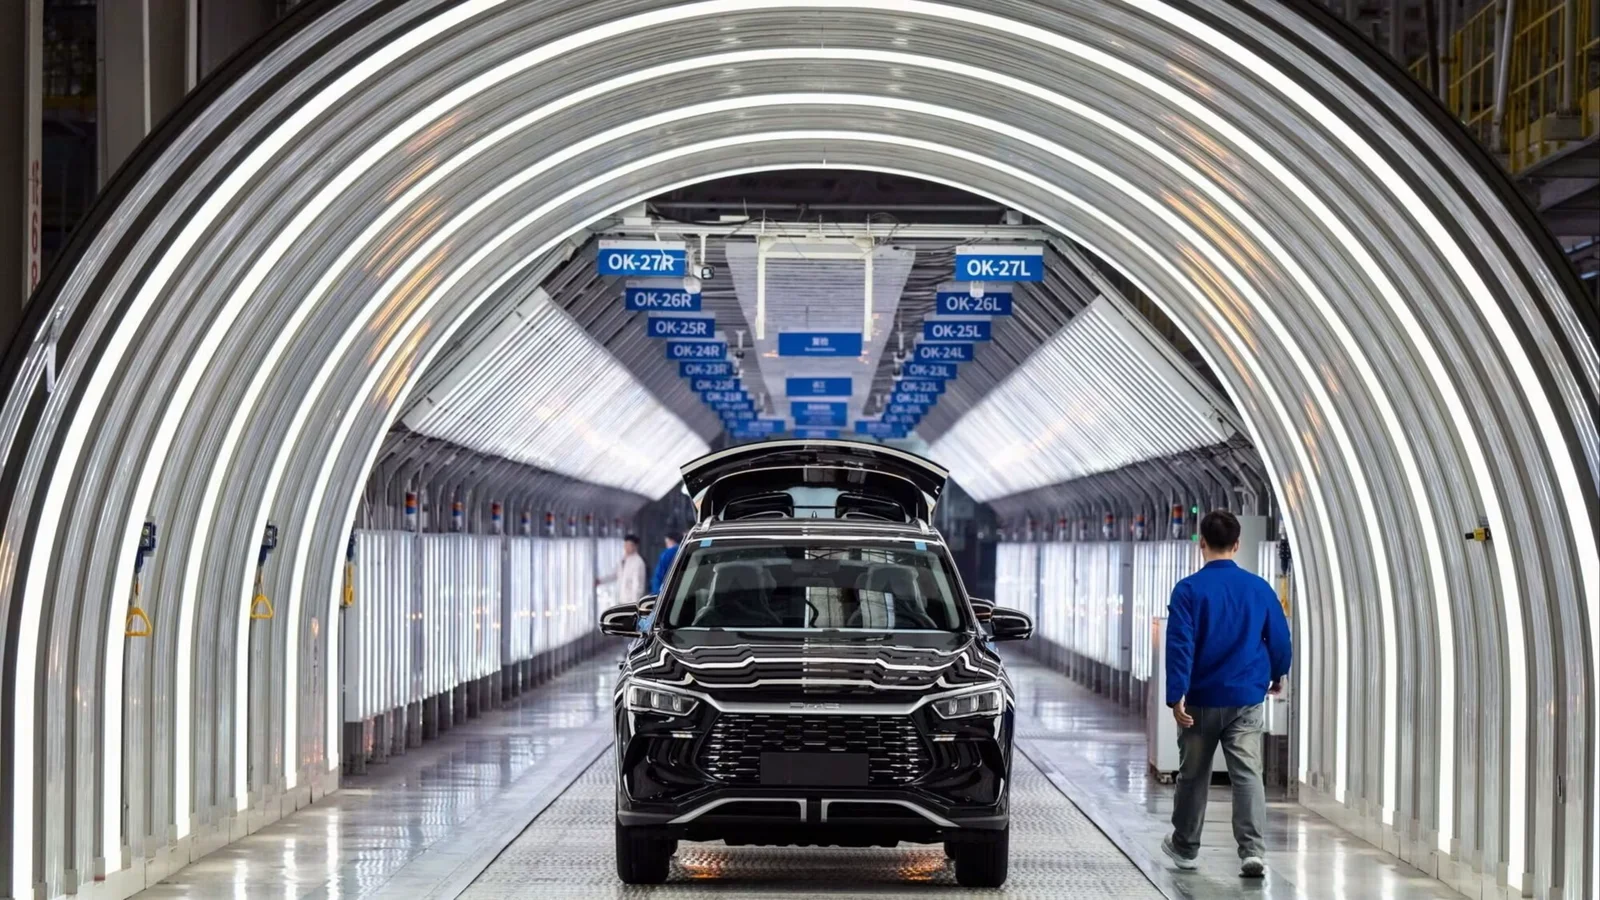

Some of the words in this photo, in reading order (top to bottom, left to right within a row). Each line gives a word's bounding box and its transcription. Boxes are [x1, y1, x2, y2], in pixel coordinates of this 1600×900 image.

[608, 253, 674, 271] OK-27R
[966, 259, 1031, 276] OK-27L
[634, 292, 692, 307] OK-26R
[946, 296, 1002, 311] OK-26L
[655, 321, 707, 335] OK-25R
[932, 324, 982, 337] OK-25L
[673, 345, 720, 357] OK-24R
[920, 347, 965, 359] OK-24L
[685, 364, 727, 375] OK-23R
[909, 364, 949, 377] OK-23L
[901, 382, 939, 392] OK-22L
